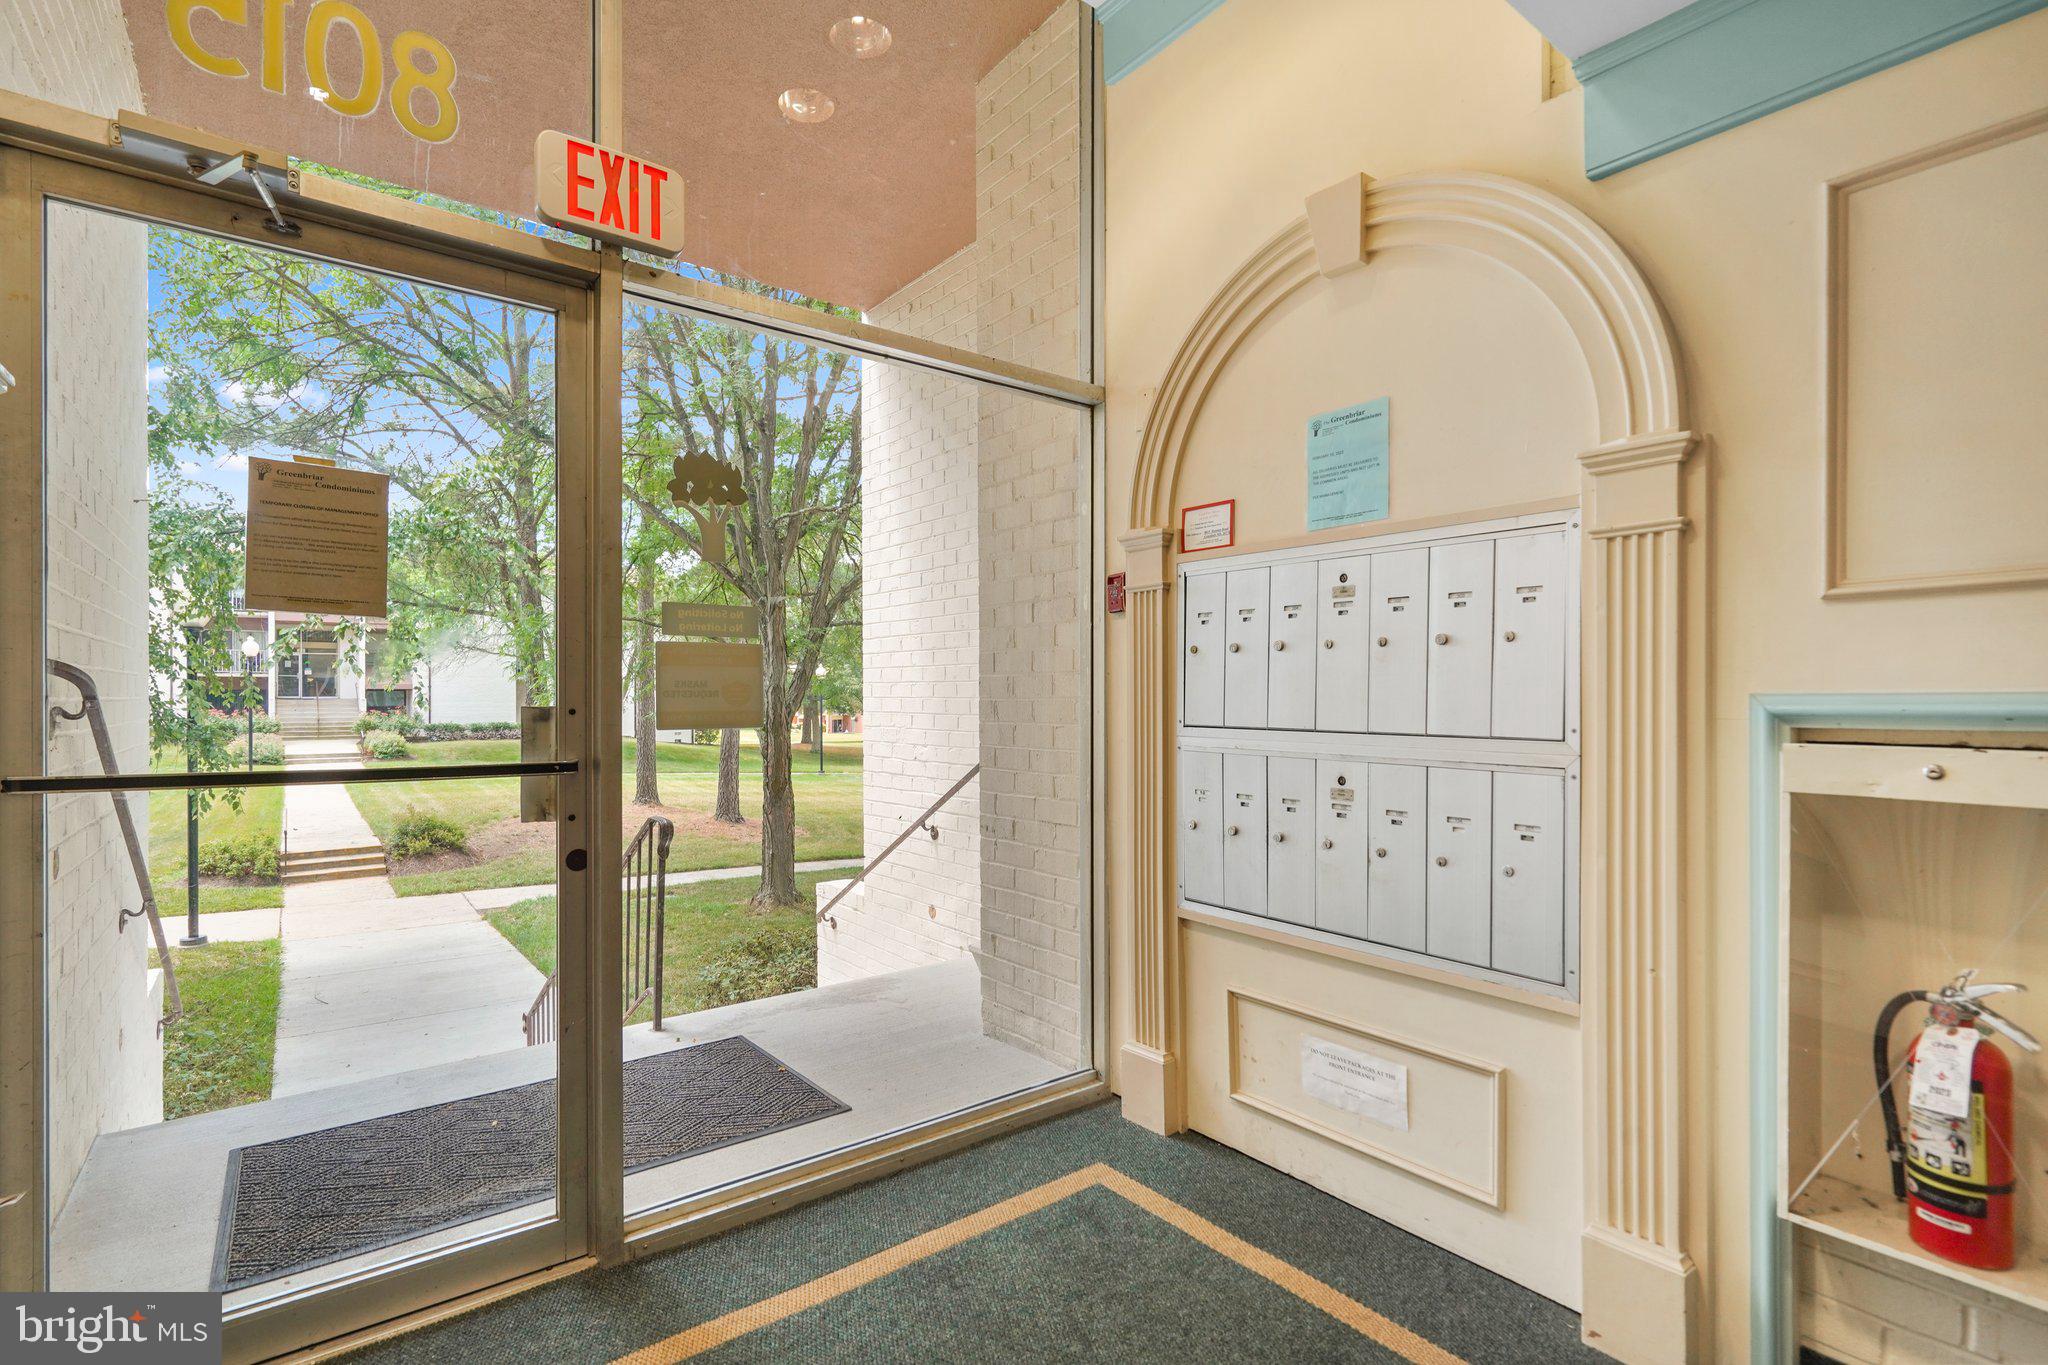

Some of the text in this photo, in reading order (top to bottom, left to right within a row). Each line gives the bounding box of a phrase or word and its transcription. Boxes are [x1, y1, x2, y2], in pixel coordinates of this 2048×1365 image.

[565, 138, 669, 241] EXIT
[1331, 409, 1365, 423] Greenbriar
[276, 468, 324, 481] Greenbriar
[315, 481, 376, 495] Condominiums
[260, 499, 292, 508] TEMPORARY
[324, 507, 362, 515] MANAGEMENT
[1319, 1051, 1329, 1059] NOT
[1330, 1053, 1346, 1064] LEAVE
[1347, 1060, 1375, 1074] PACKAGES
[1328, 1061, 1347, 1072] FRONT
[1347, 1067, 1376, 1081] ENTRANCE
